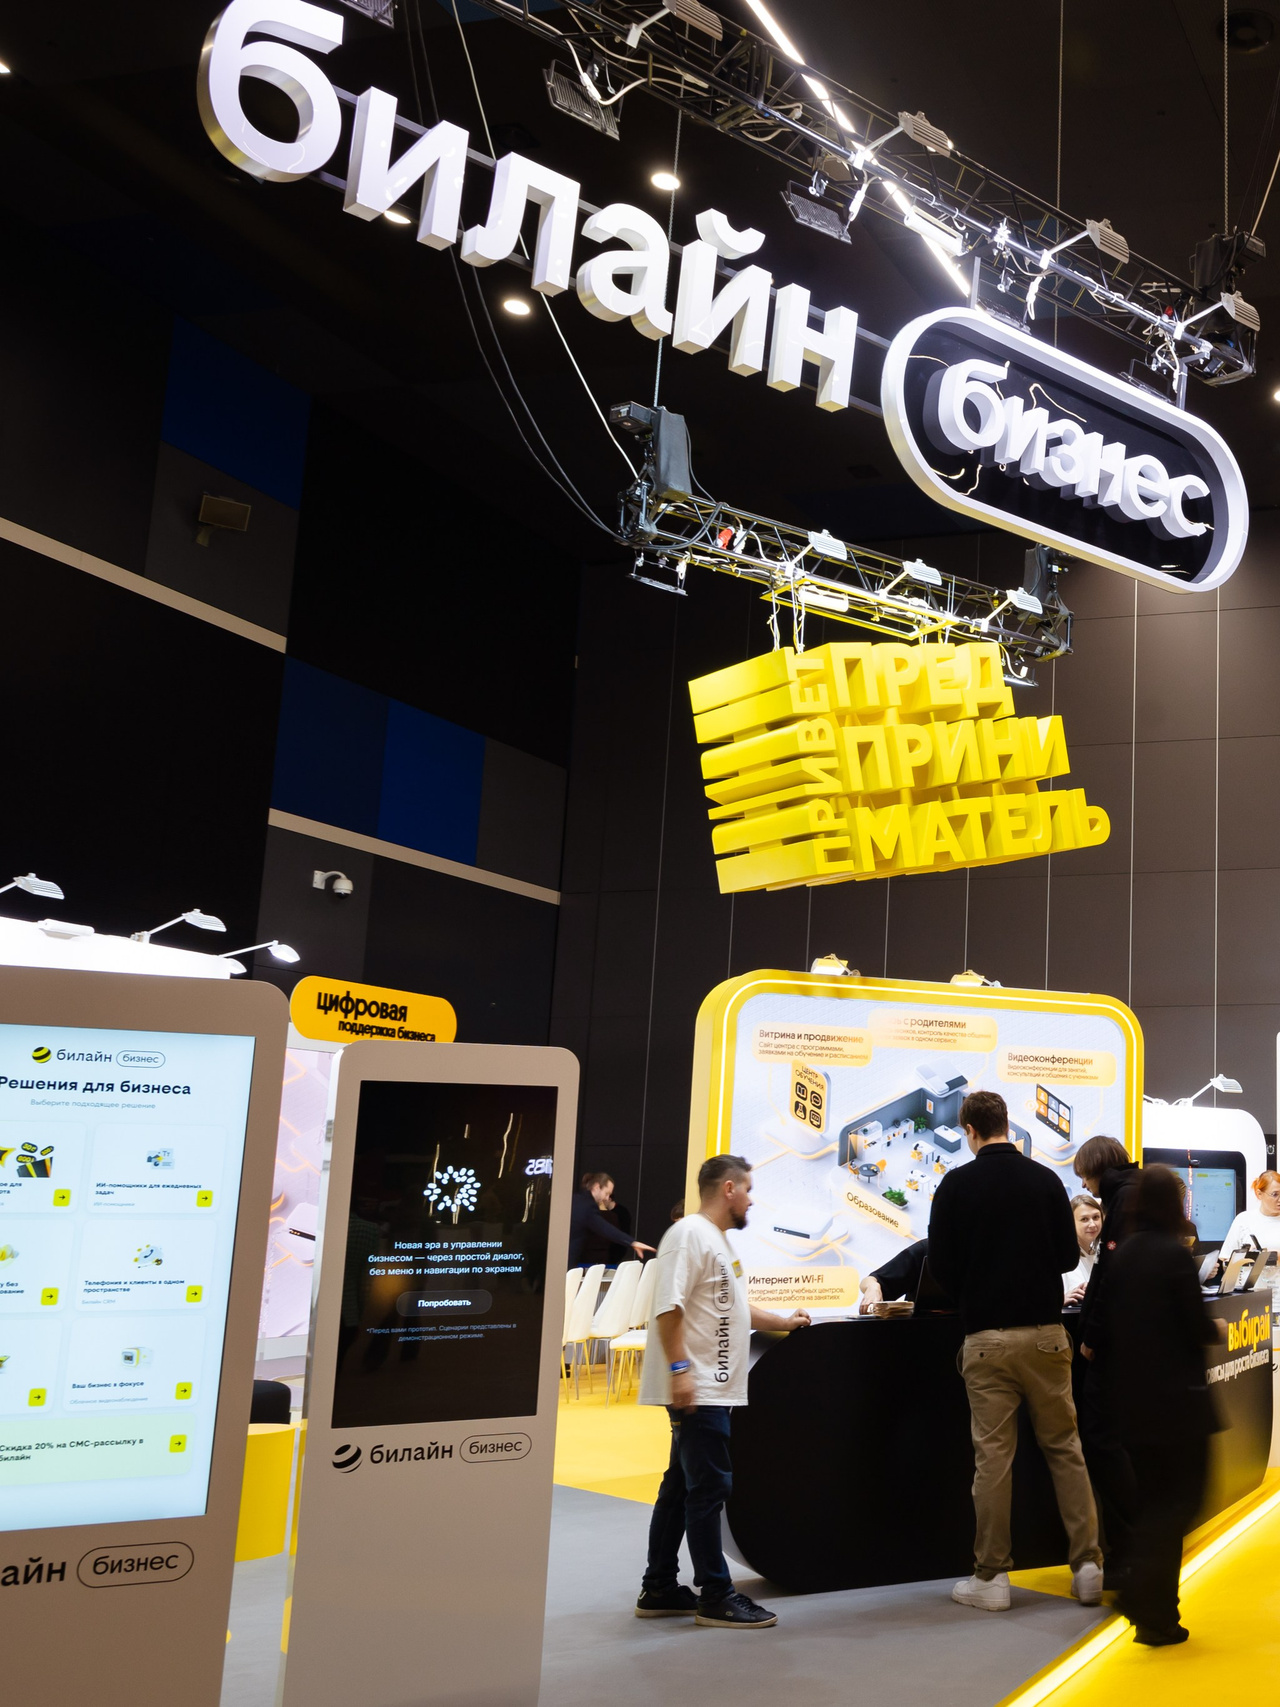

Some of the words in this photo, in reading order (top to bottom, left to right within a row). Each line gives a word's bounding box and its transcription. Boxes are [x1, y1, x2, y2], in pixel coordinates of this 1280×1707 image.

[199, 0, 857, 412] билайн
[930, 358, 1210, 541] бизнес
[825, 642, 1015, 719] ПРЕД
[838, 715, 1071, 793] ПРИНИ
[848, 788, 1110, 872] МАТЕЛЬ
[317, 991, 408, 1022] цифровая
[338, 1020, 396, 1038] поддержка
[398, 1026, 436, 1042] бизнеса
[910, 1018, 966, 1029] родителями
[759, 1030, 795, 1040] Витрина
[804, 1034, 863, 1043] продвижение
[56, 1049, 112, 1063] билайн
[122, 1053, 159, 1064] бизнес
[1008, 1053, 1093, 1065] Видеоконференции
[795, 1070, 823, 1091] ОБУЧЕНИЯ
[802, 1066, 818, 1078] ЦЕНТР
[0, 1076, 78, 1091] Решения
[82, 1079, 115, 1093] для
[120, 1080, 191, 1095] бизнеса
[30, 1099, 70, 1107] Выберите
[72, 1100, 119, 1109] подходящее
[847, 1192, 899, 1228] Образование
[394, 1241, 422, 1249] Новая
[424, 1242, 441, 1250] эра
[450, 1241, 502, 1250] управлении
[368, 1254, 413, 1263] бизнесом
[427, 1254, 453, 1262] через
[455, 1252, 491, 1262] простой
[492, 1252, 525, 1261] диалог,
[369, 1267, 386, 1276] без
[424, 1267, 470, 1275] навигации
[484, 1266, 522, 1274] экранам
[749, 1276, 792, 1285] Интернет
[801, 1275, 824, 1283] Wi-Fi
[718, 1262, 728, 1304] бизнес
[417, 1299, 472, 1308] Попробовать
[1228, 1305, 1270, 1352] выбирай
[714, 1317, 730, 1383] билайн
[1250, 1349, 1269, 1368] бизнеса
[119, 1380, 144, 1388] фокусе
[69, 1439, 136, 1449] СМС-рассылку
[370, 1441, 453, 1464] билайн
[469, 1441, 522, 1455] бизнес
[93, 1554, 179, 1575] бизнес
